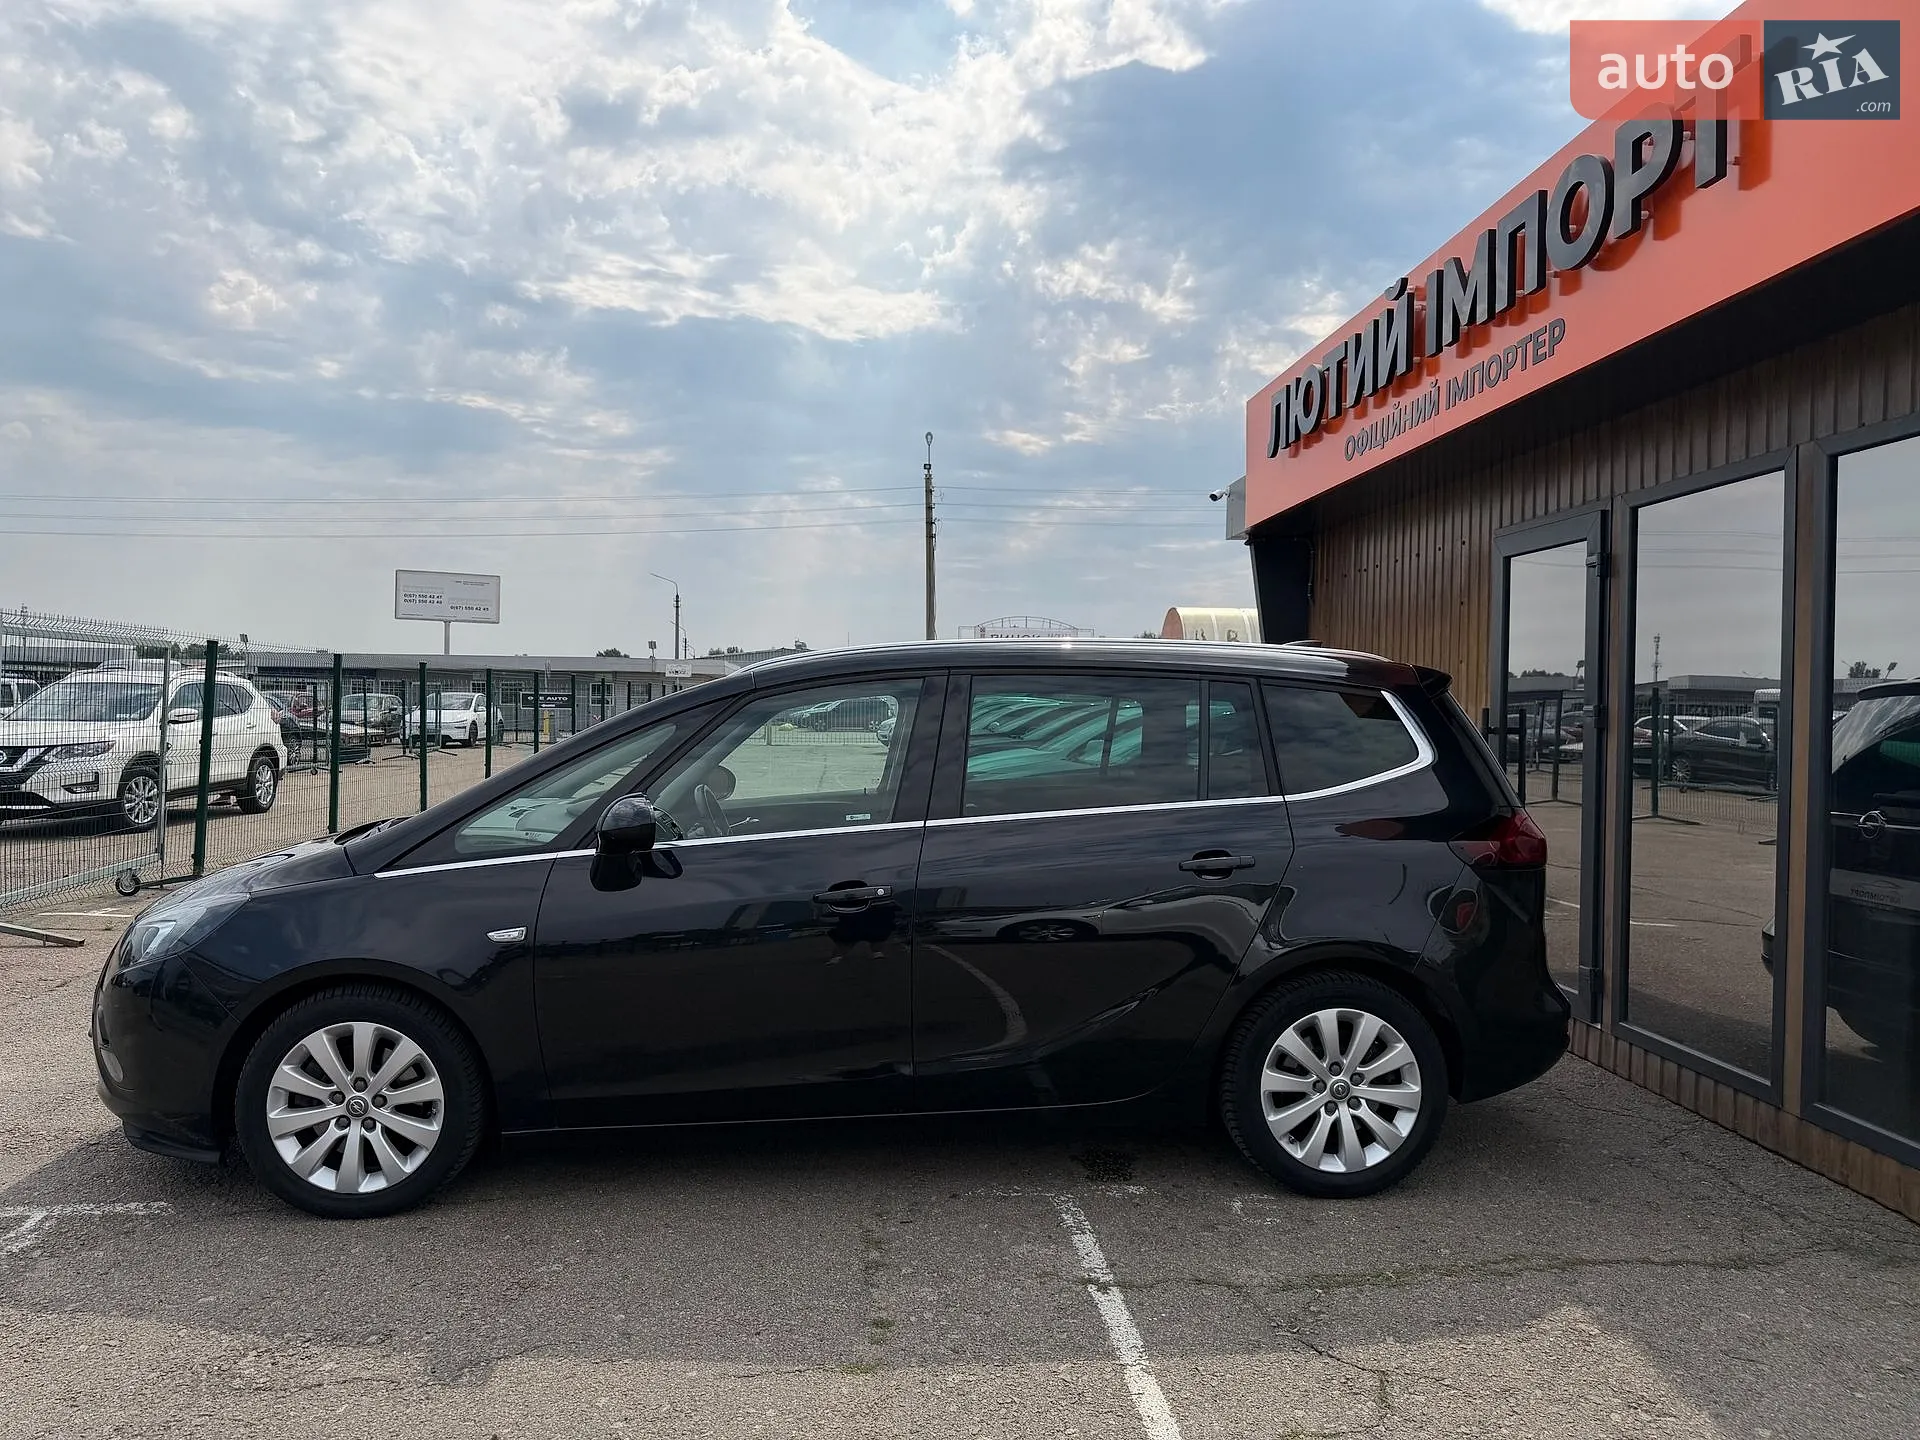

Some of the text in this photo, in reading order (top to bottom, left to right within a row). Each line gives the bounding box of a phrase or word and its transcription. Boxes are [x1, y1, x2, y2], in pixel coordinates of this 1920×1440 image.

[1267, 34, 1752, 458] ЛЮТИЙ ІМПОРТ
[1344, 317, 1566, 461] ОФІЦІЙНИЙ ІМПОРТЕР
